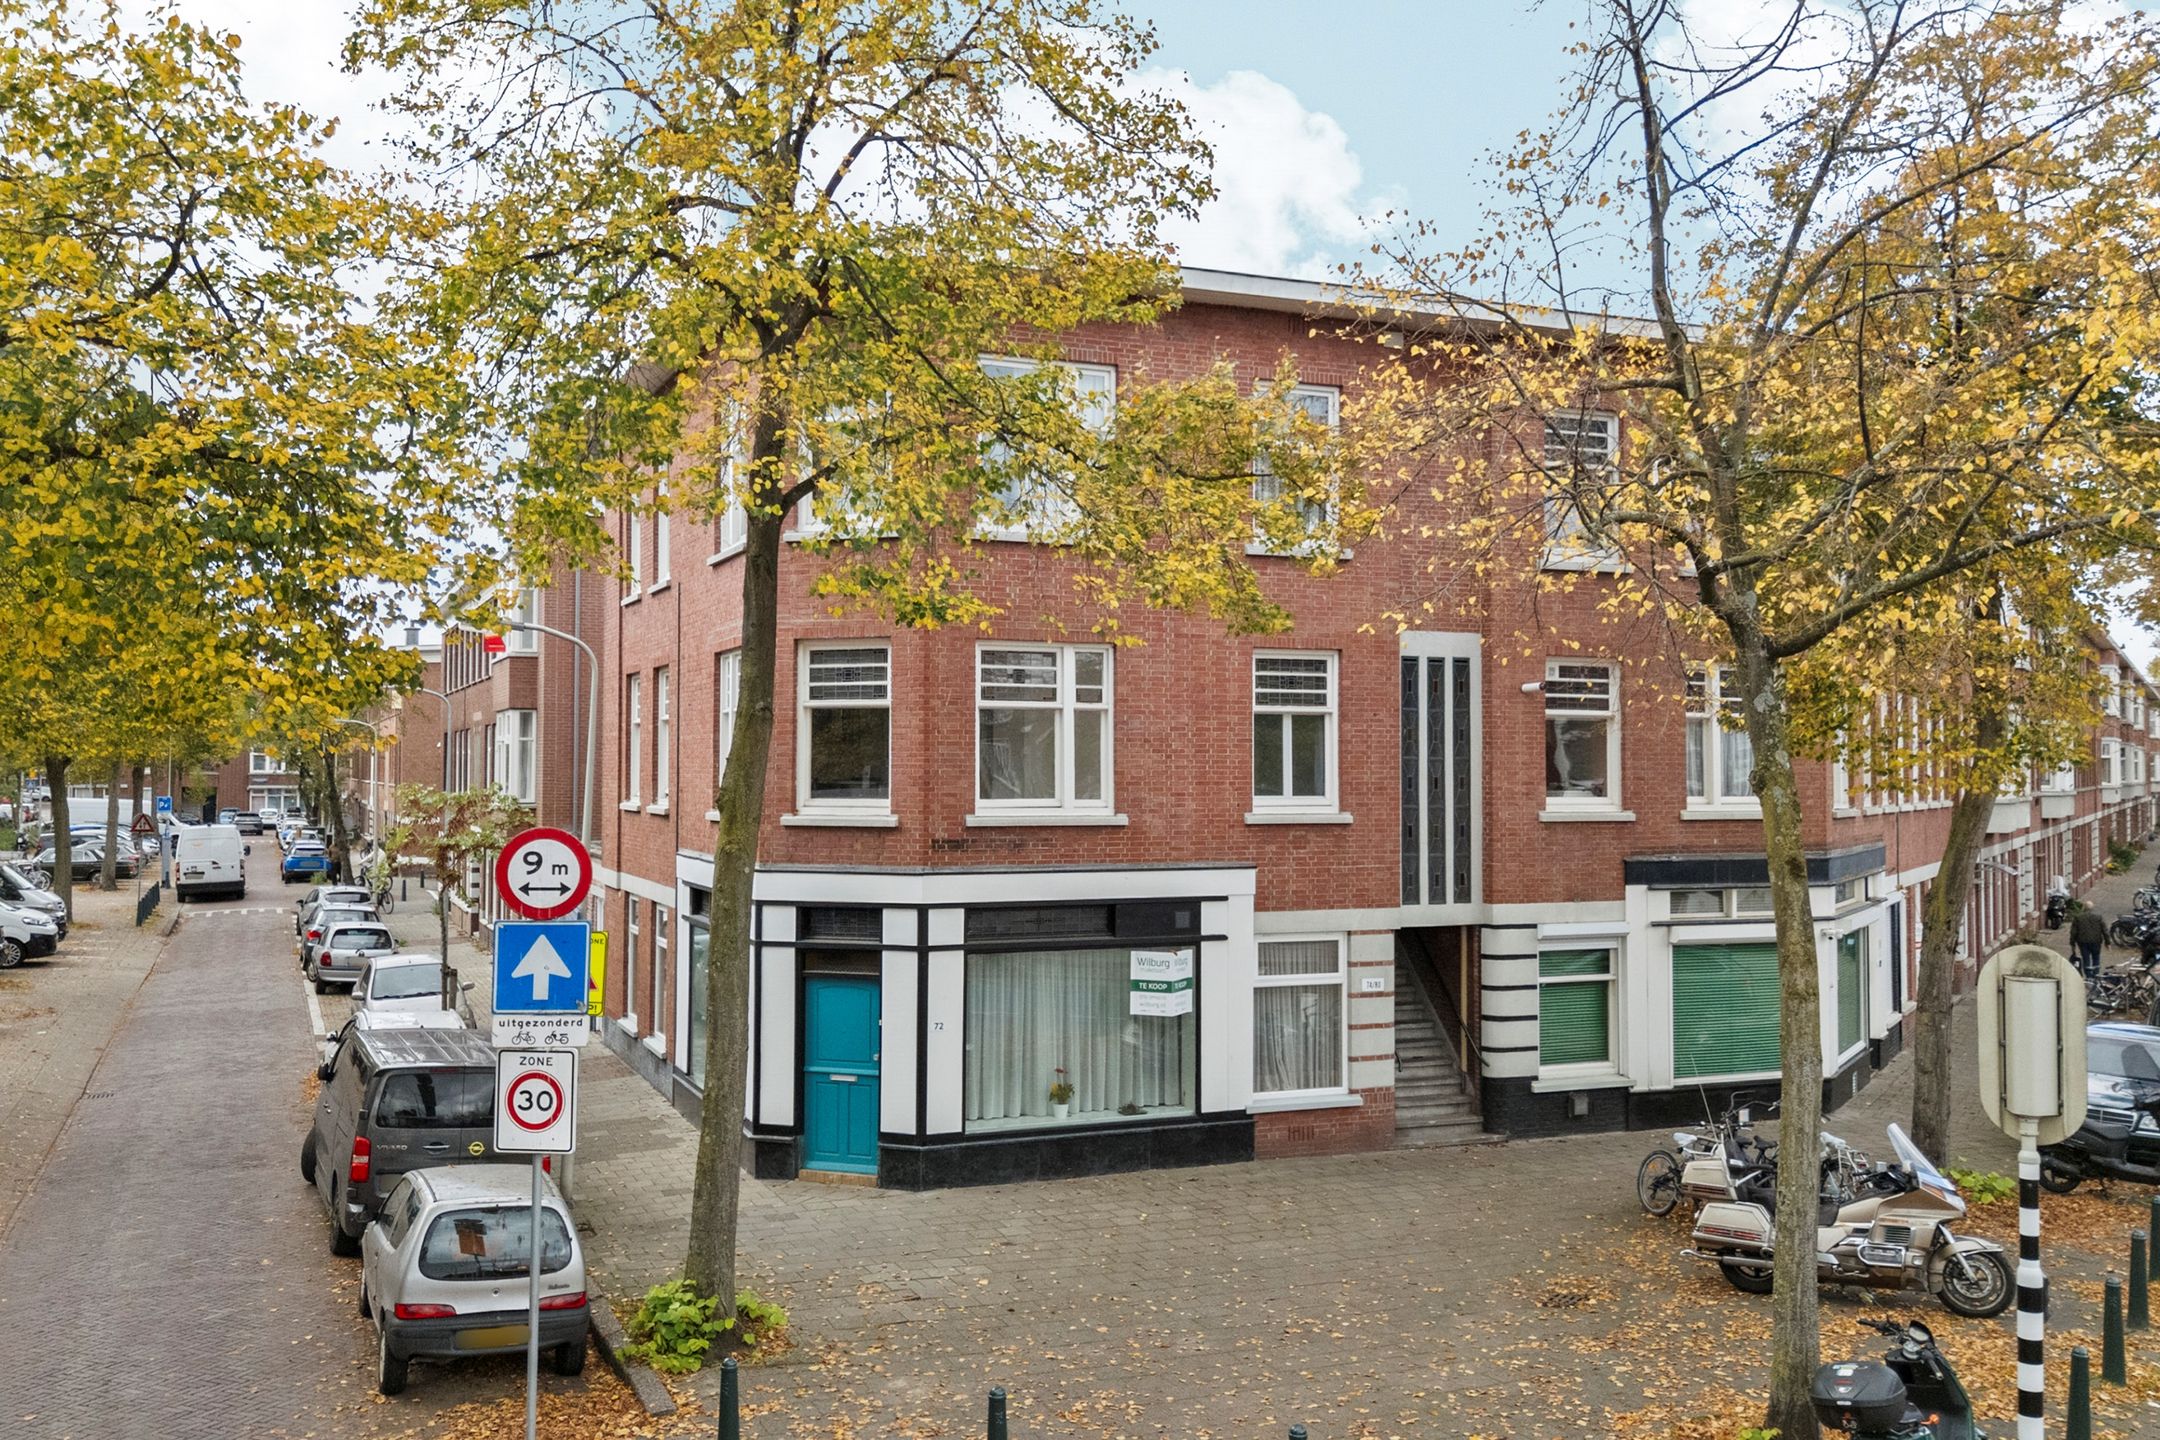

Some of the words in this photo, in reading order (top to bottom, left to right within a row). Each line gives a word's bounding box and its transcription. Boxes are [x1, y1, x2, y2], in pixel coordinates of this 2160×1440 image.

[523, 851, 543, 875] 9
[551, 864, 569, 875] m
[1136, 957, 1171, 969] Wilburg
[499, 1018, 583, 1029] uitgezonderd
[934, 1022, 944, 1030] 72
[519, 1056, 553, 1066] ZONE
[517, 1090, 554, 1112] 30
